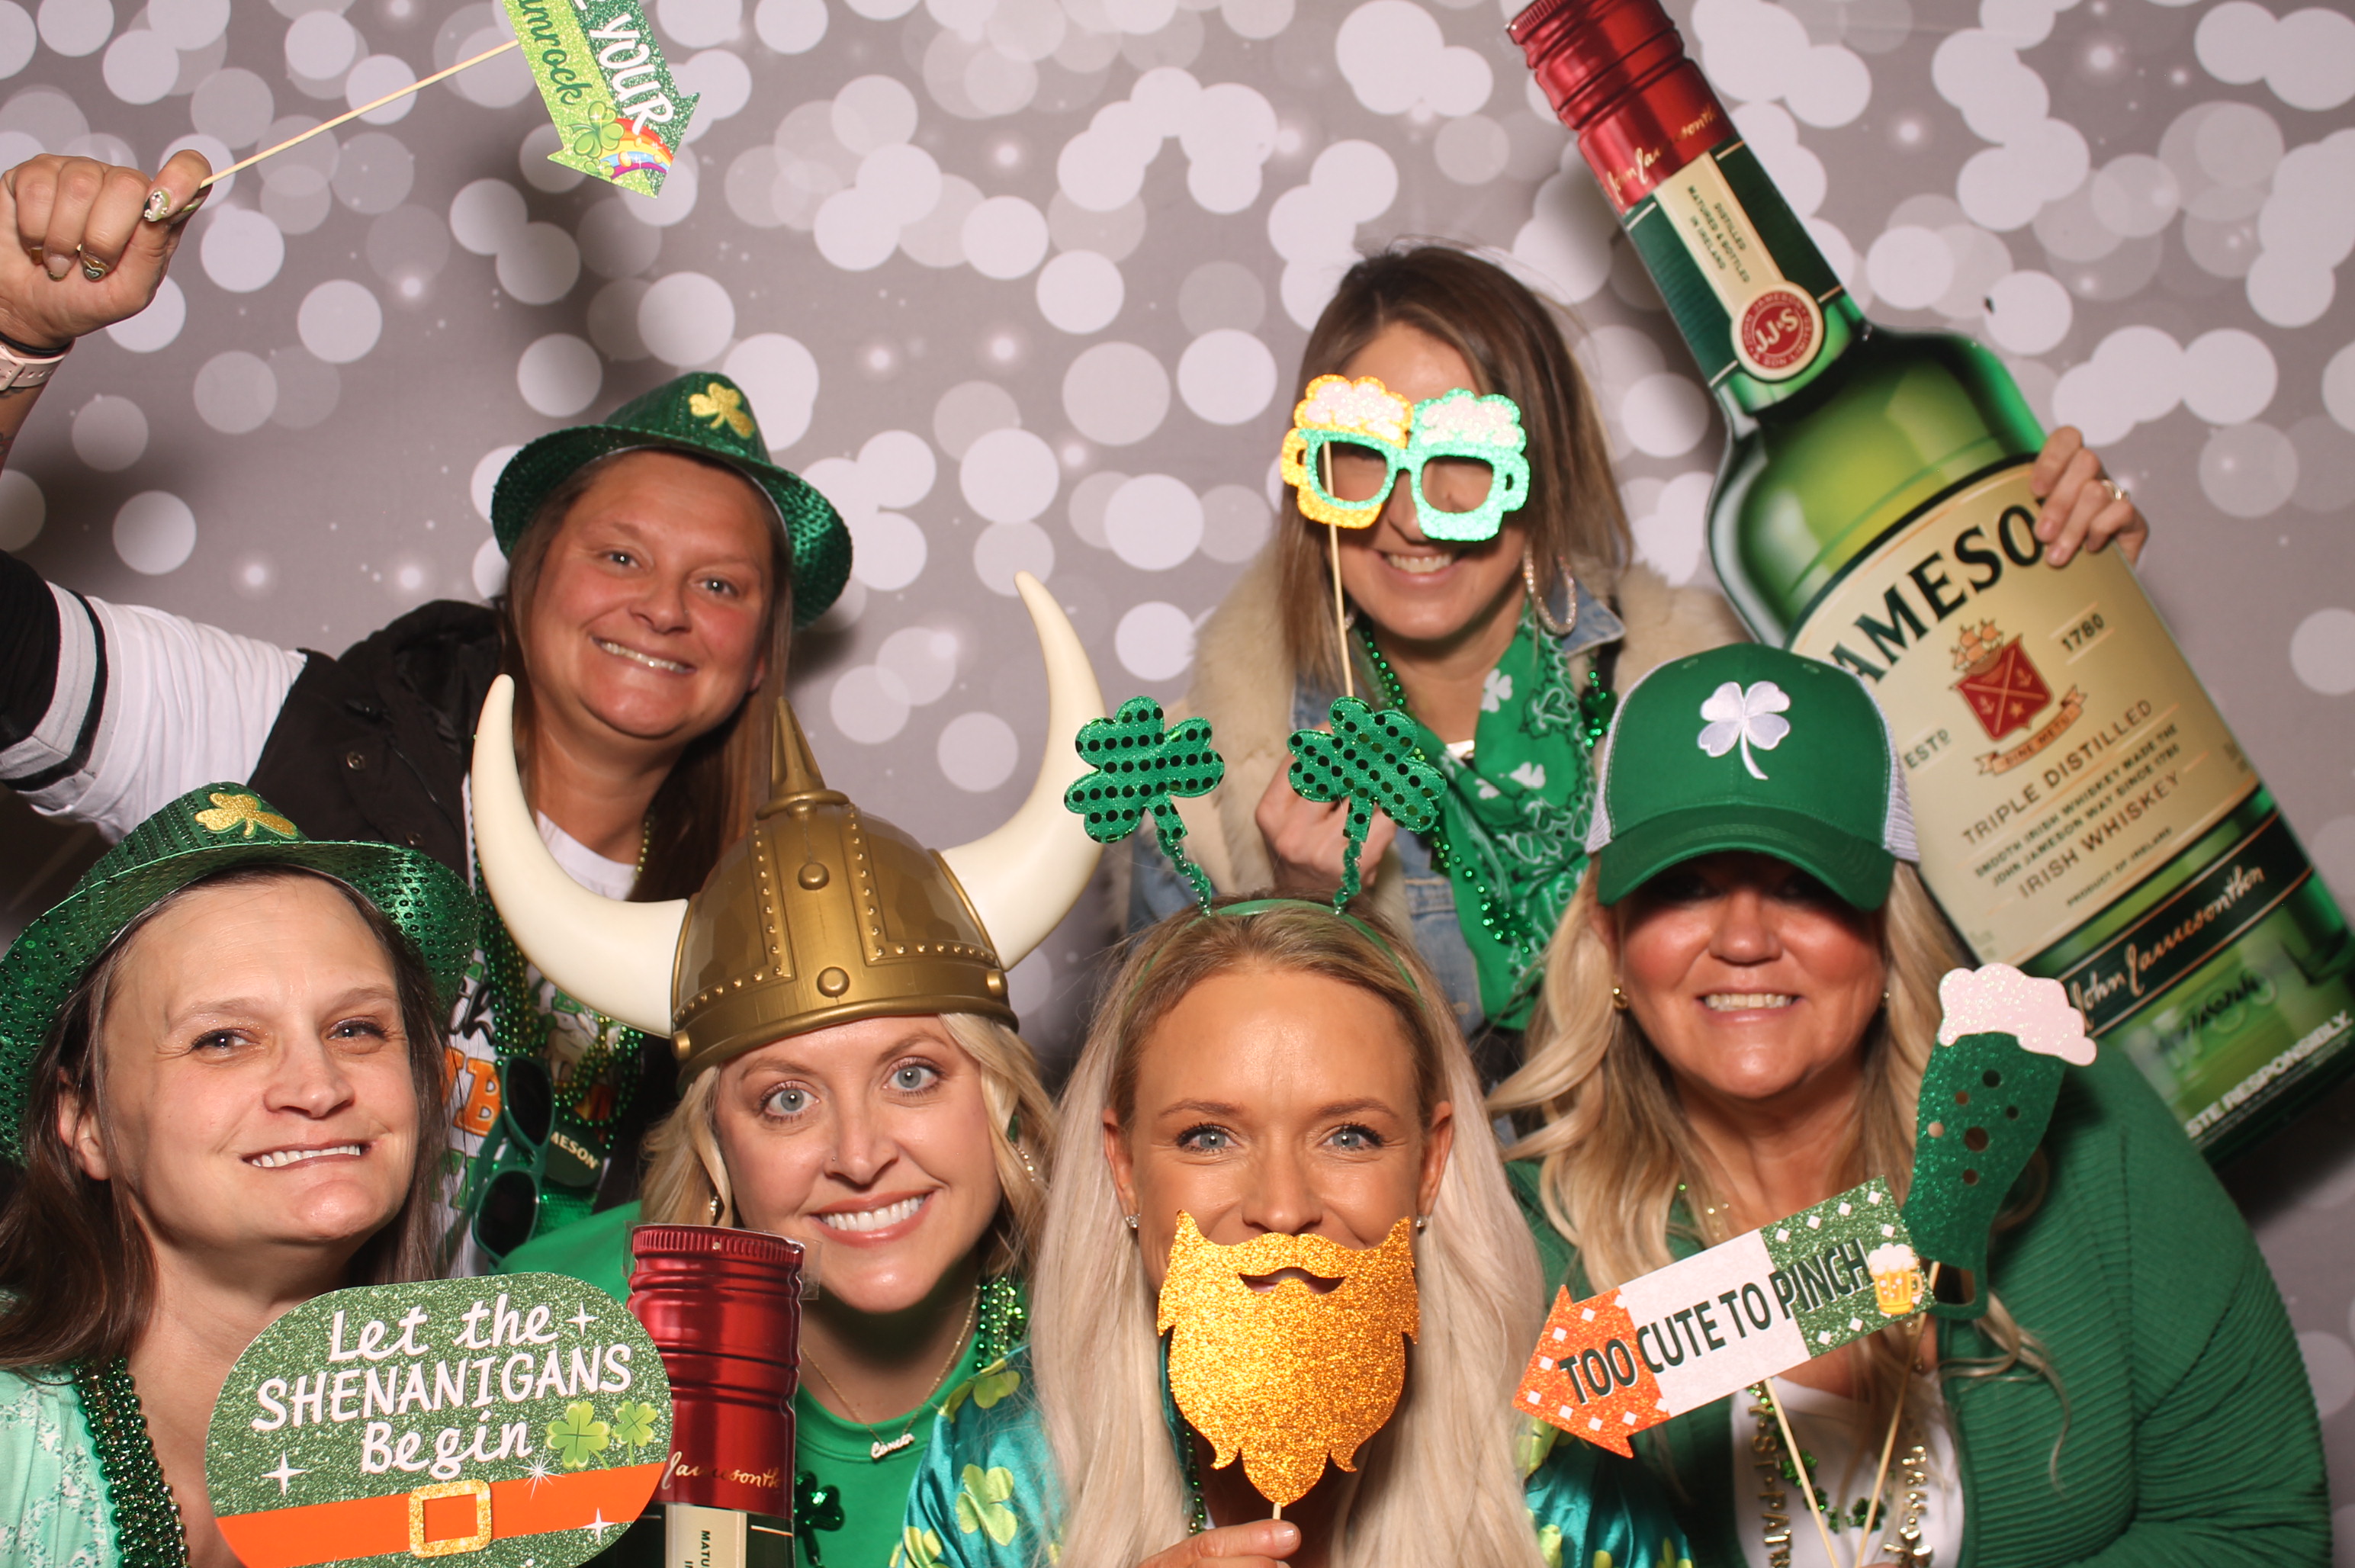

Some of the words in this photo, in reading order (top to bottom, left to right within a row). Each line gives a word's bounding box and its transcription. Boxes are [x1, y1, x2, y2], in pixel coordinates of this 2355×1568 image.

[589, 13, 674, 136] YOUR
[1687, 185, 1718, 230] MATURED
[1721, 239, 1750, 283] BOTTLED
[1698, 228, 1727, 269] IRELAND
[1714, 202, 1746, 250] DISTILLED
[1830, 496, 2047, 684] AMESO
[2061, 613, 2106, 651] 1780
[1962, 783, 2041, 844] TRIPLE
[2043, 699, 2152, 789] DISTILLED
[1975, 840, 2022, 877] SMOOTH
[2025, 814, 2060, 843] IRISH
[2061, 765, 2120, 815] WHISKEY
[2122, 741, 2157, 770] MADE
[2156, 723, 2179, 743] THE
[1994, 862, 2022, 887] JOHN
[2025, 818, 2084, 866] JAMESON
[2084, 792, 2114, 819] WAY
[2116, 765, 2154, 798] SINCE
[2018, 847, 2080, 898] IRISH
[2080, 770, 2180, 852] WHISKEY
[2066, 868, 2112, 906] PRODUCT
[2115, 859, 2128, 872] OF
[2129, 826, 2173, 860] IRELAND
[2070, 970, 2126, 1031] John
[2185, 1100, 2226, 1139] STE
[328, 1305, 430, 1362] Let
[453, 1293, 559, 1349] the
[1557, 1338, 1638, 1406] TOO
[1636, 1301, 1727, 1374] CUTE
[1720, 1281, 1774, 1340] TO
[1769, 1238, 1875, 1319] PINCH
[251, 1343, 633, 1431] SHENANIGANS
[360, 1407, 533, 1483] Begin
[700, 1530, 711, 1568] MATU
